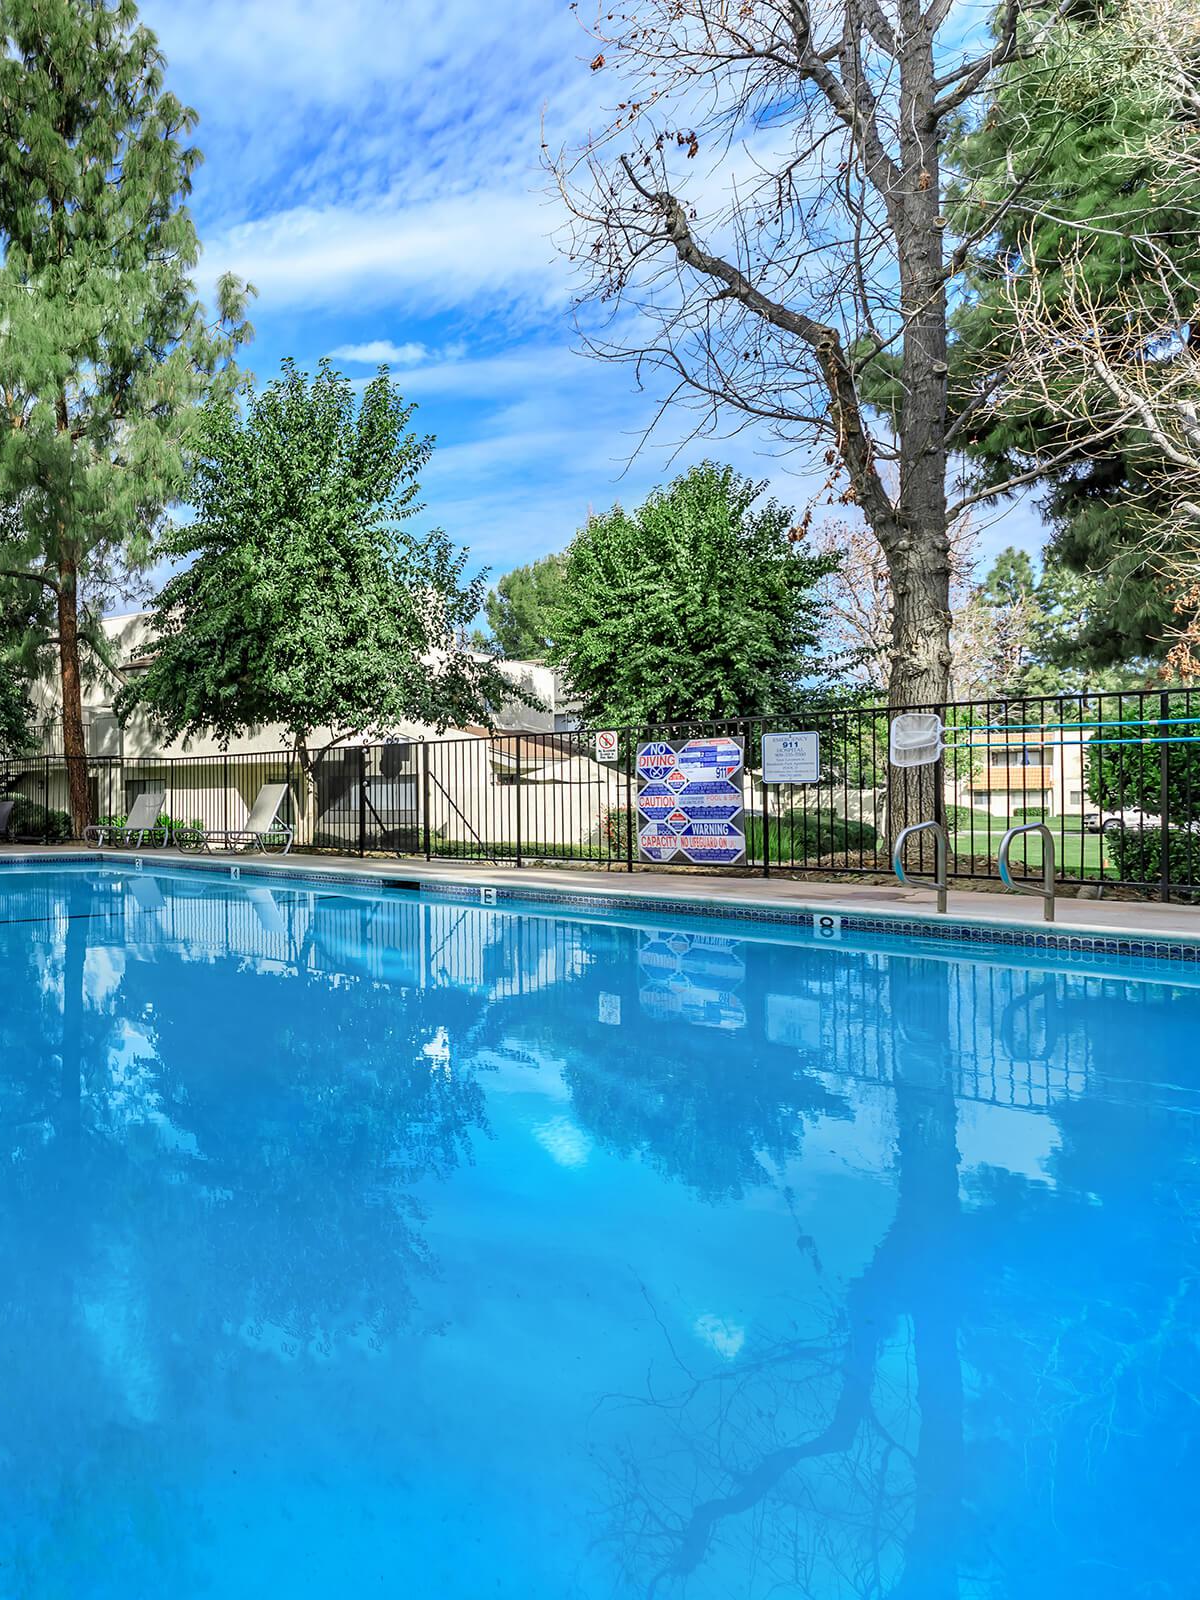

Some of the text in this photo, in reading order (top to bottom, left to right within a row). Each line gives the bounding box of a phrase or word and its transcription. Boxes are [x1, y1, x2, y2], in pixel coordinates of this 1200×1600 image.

[651, 743, 665, 755] NO
[640, 754, 676, 767] DIVING
[716, 767, 727, 779] 911
[639, 796, 675, 807] CAUTION
[691, 823, 729, 835] WARNING
[641, 836, 677, 847] CAPACITY
[681, 837, 689, 848] NO
[690, 837, 718, 848] LIFEGUARD
[719, 837, 728, 848] ON
